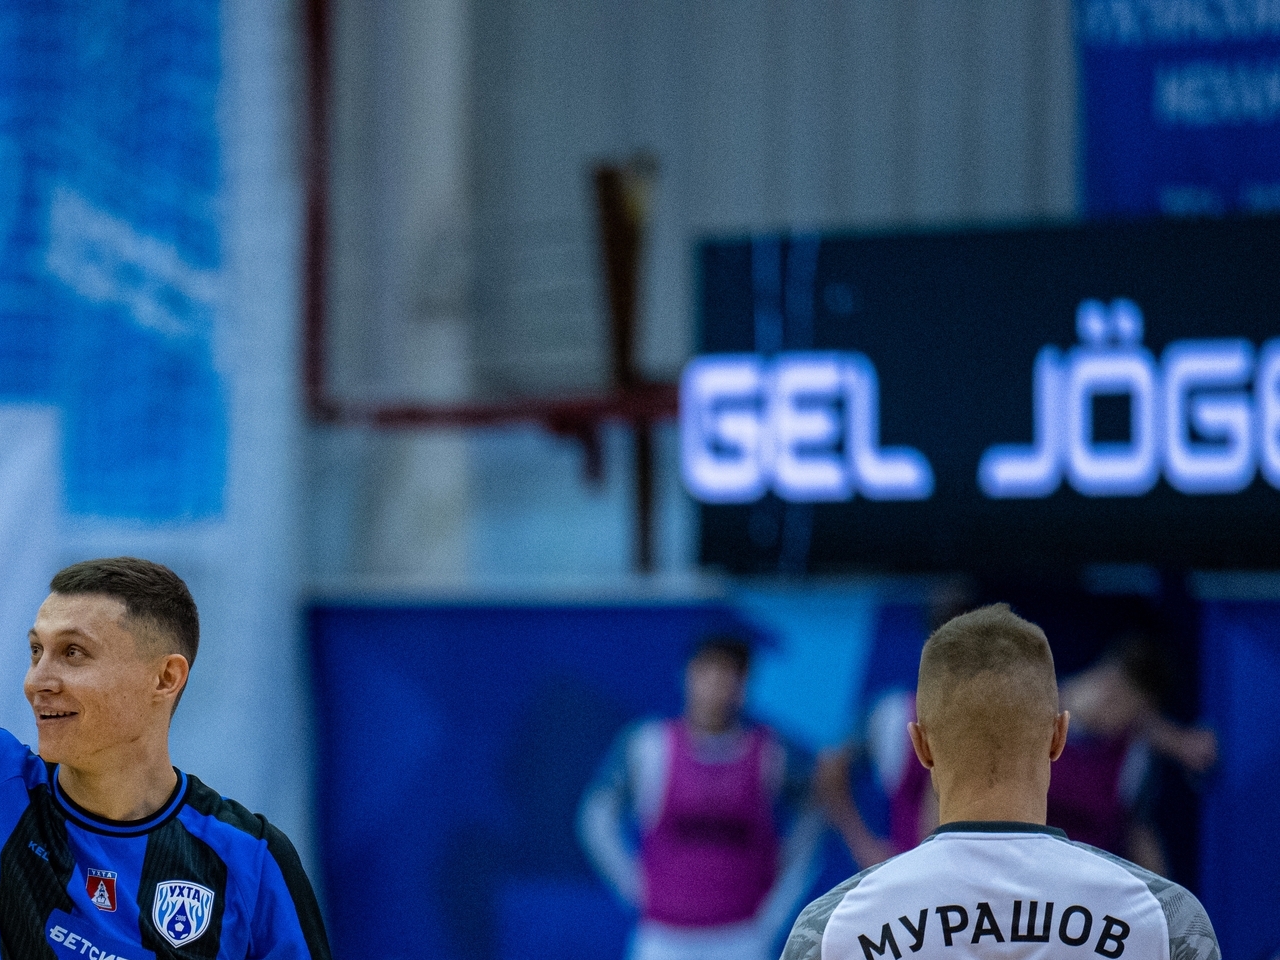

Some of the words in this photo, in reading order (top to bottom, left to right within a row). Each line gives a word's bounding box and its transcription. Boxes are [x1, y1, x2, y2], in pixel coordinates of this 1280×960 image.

[680, 351, 934, 503] GEL
[977, 298, 1280, 498] JÖG
[28, 840, 49, 861] KEL
[169, 885, 201, 903] УХТА
